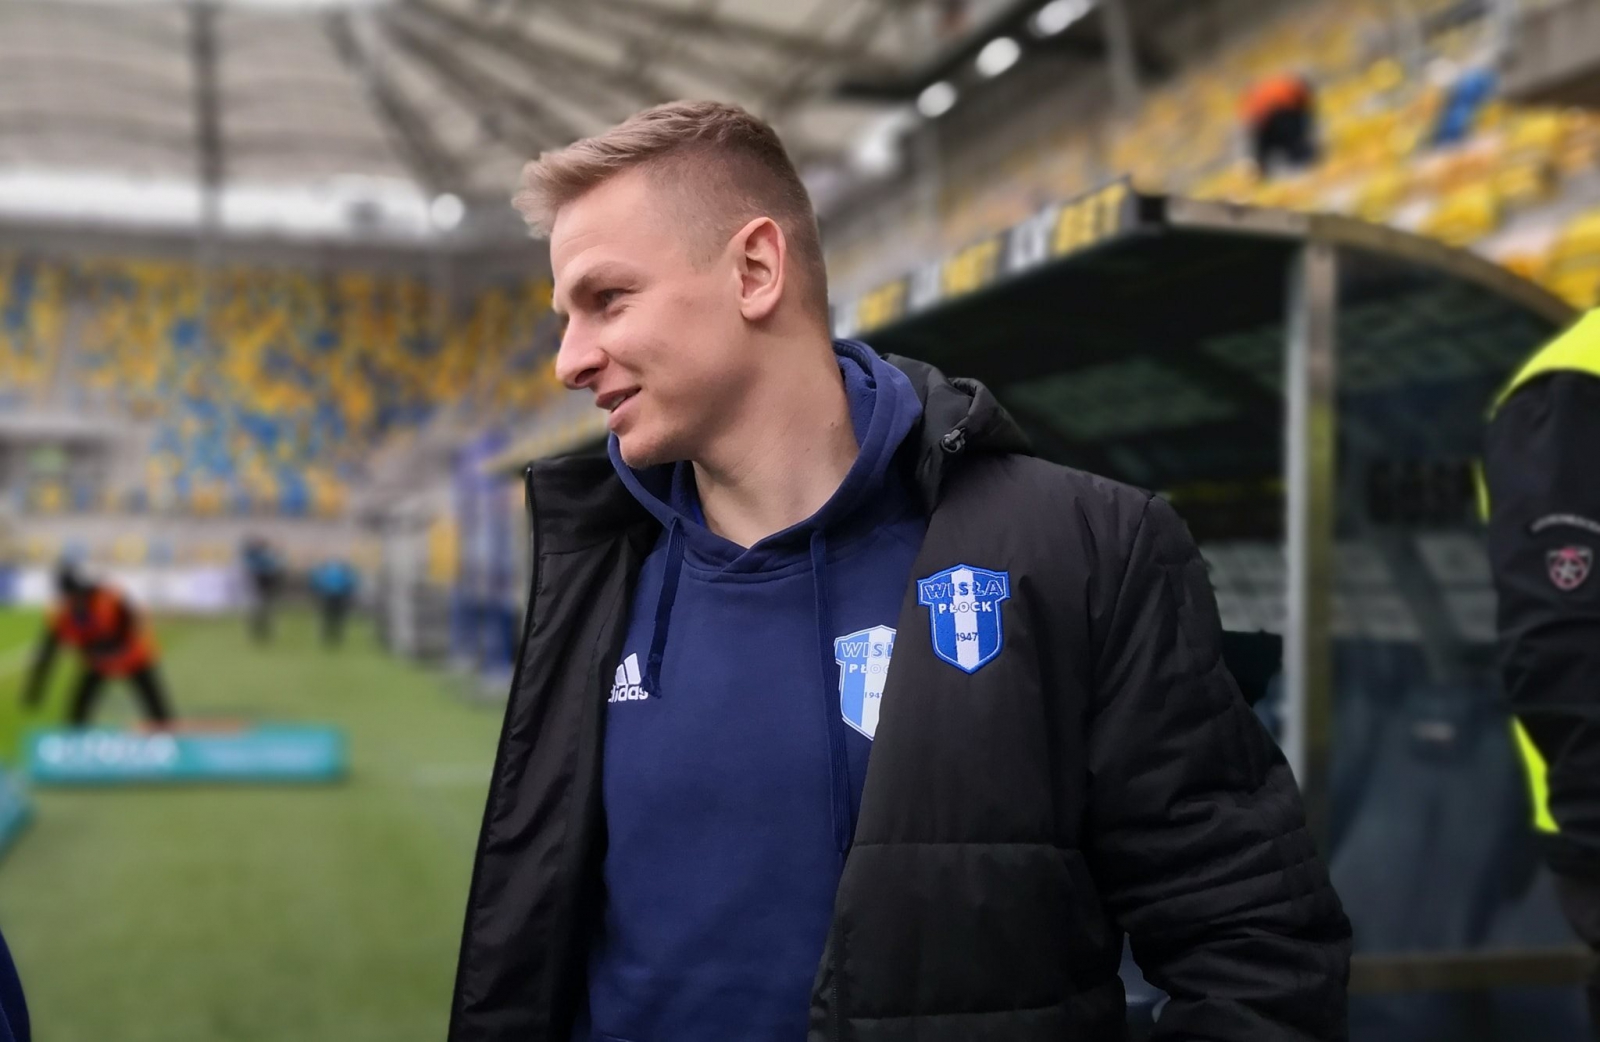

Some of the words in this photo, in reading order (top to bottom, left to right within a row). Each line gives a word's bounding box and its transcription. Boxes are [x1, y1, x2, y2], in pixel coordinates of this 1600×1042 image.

[924, 579, 1004, 600] WISŁA
[938, 601, 993, 614] PŁOCK
[956, 632, 978, 642] 1947
